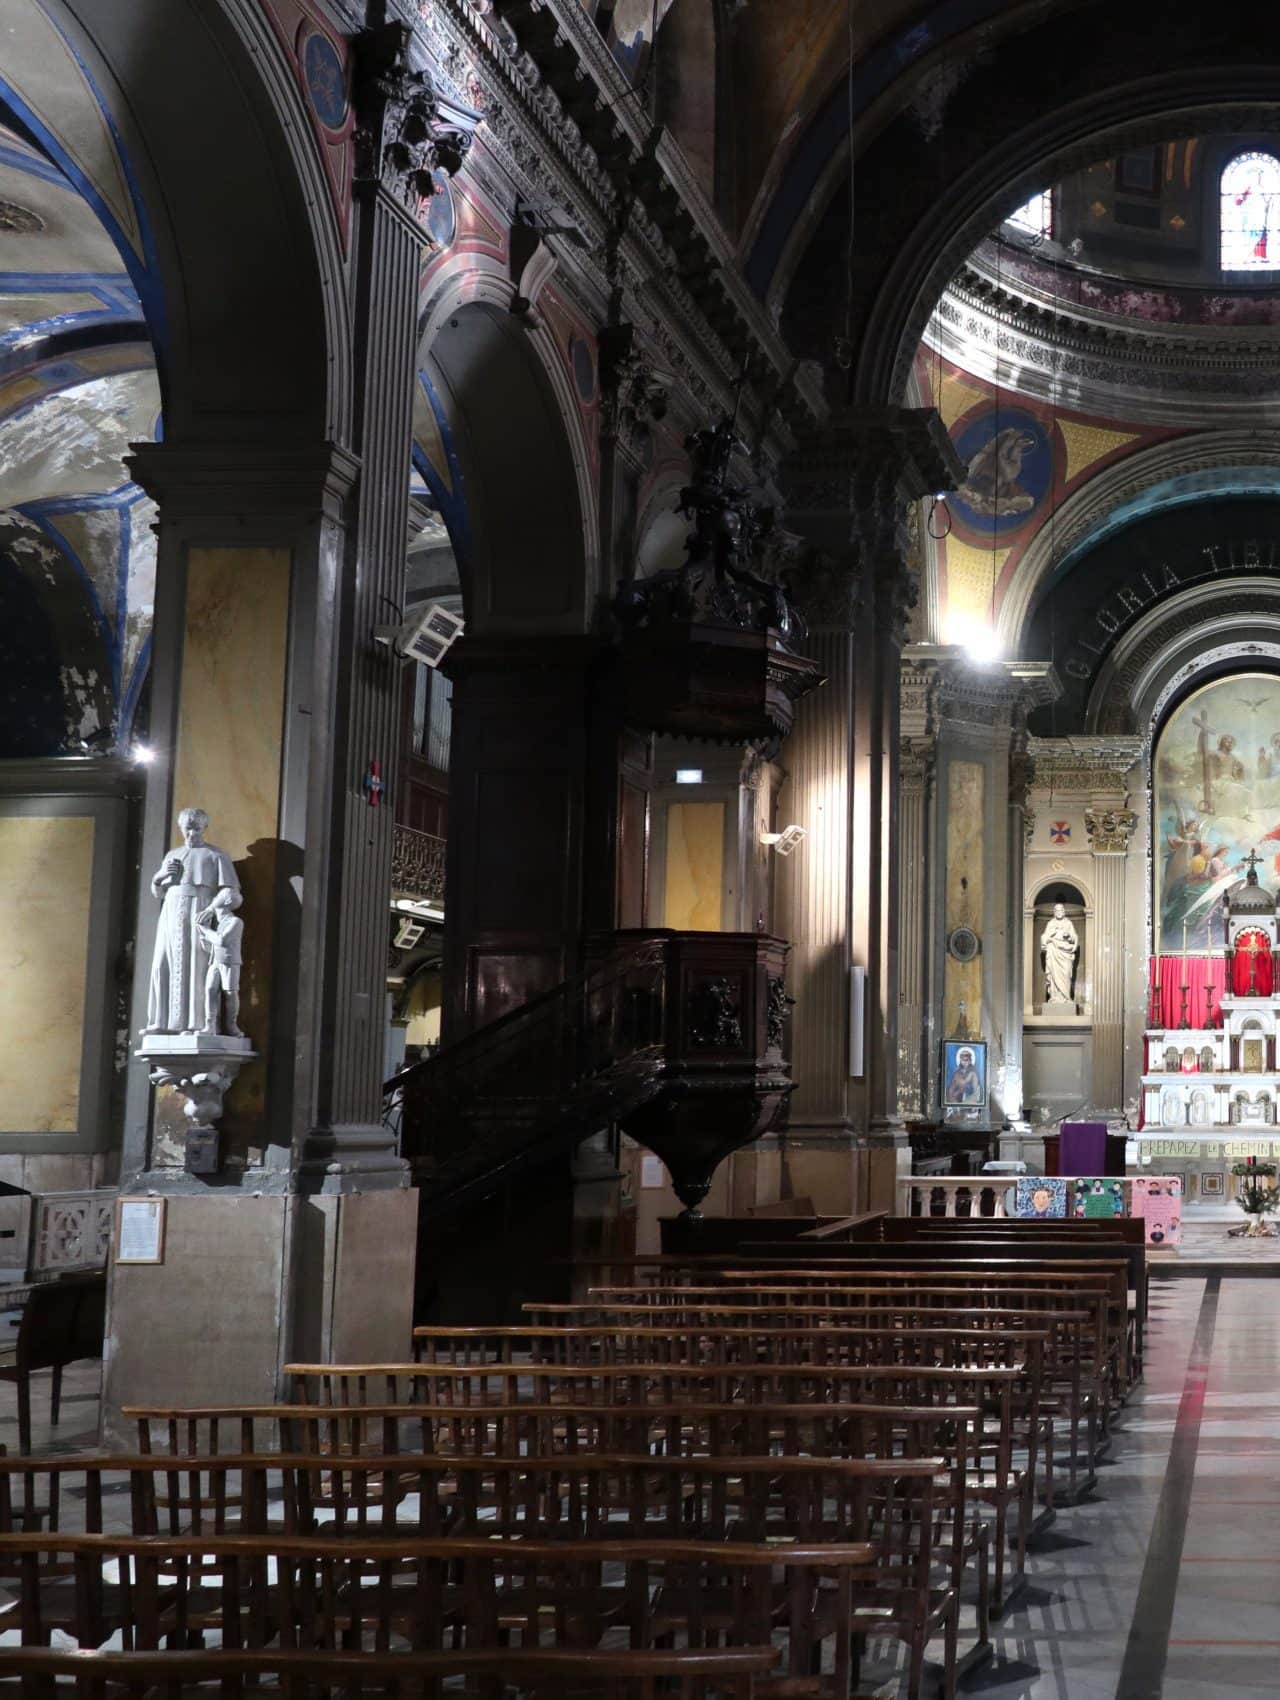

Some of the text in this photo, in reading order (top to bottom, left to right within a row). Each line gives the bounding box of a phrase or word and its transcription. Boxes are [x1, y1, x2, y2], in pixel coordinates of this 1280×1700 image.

[1064, 563, 1181, 679] GLORIA
[1200, 541, 1275, 572] TIBI
[1224, 1141, 1269, 1155] CHEMIN
